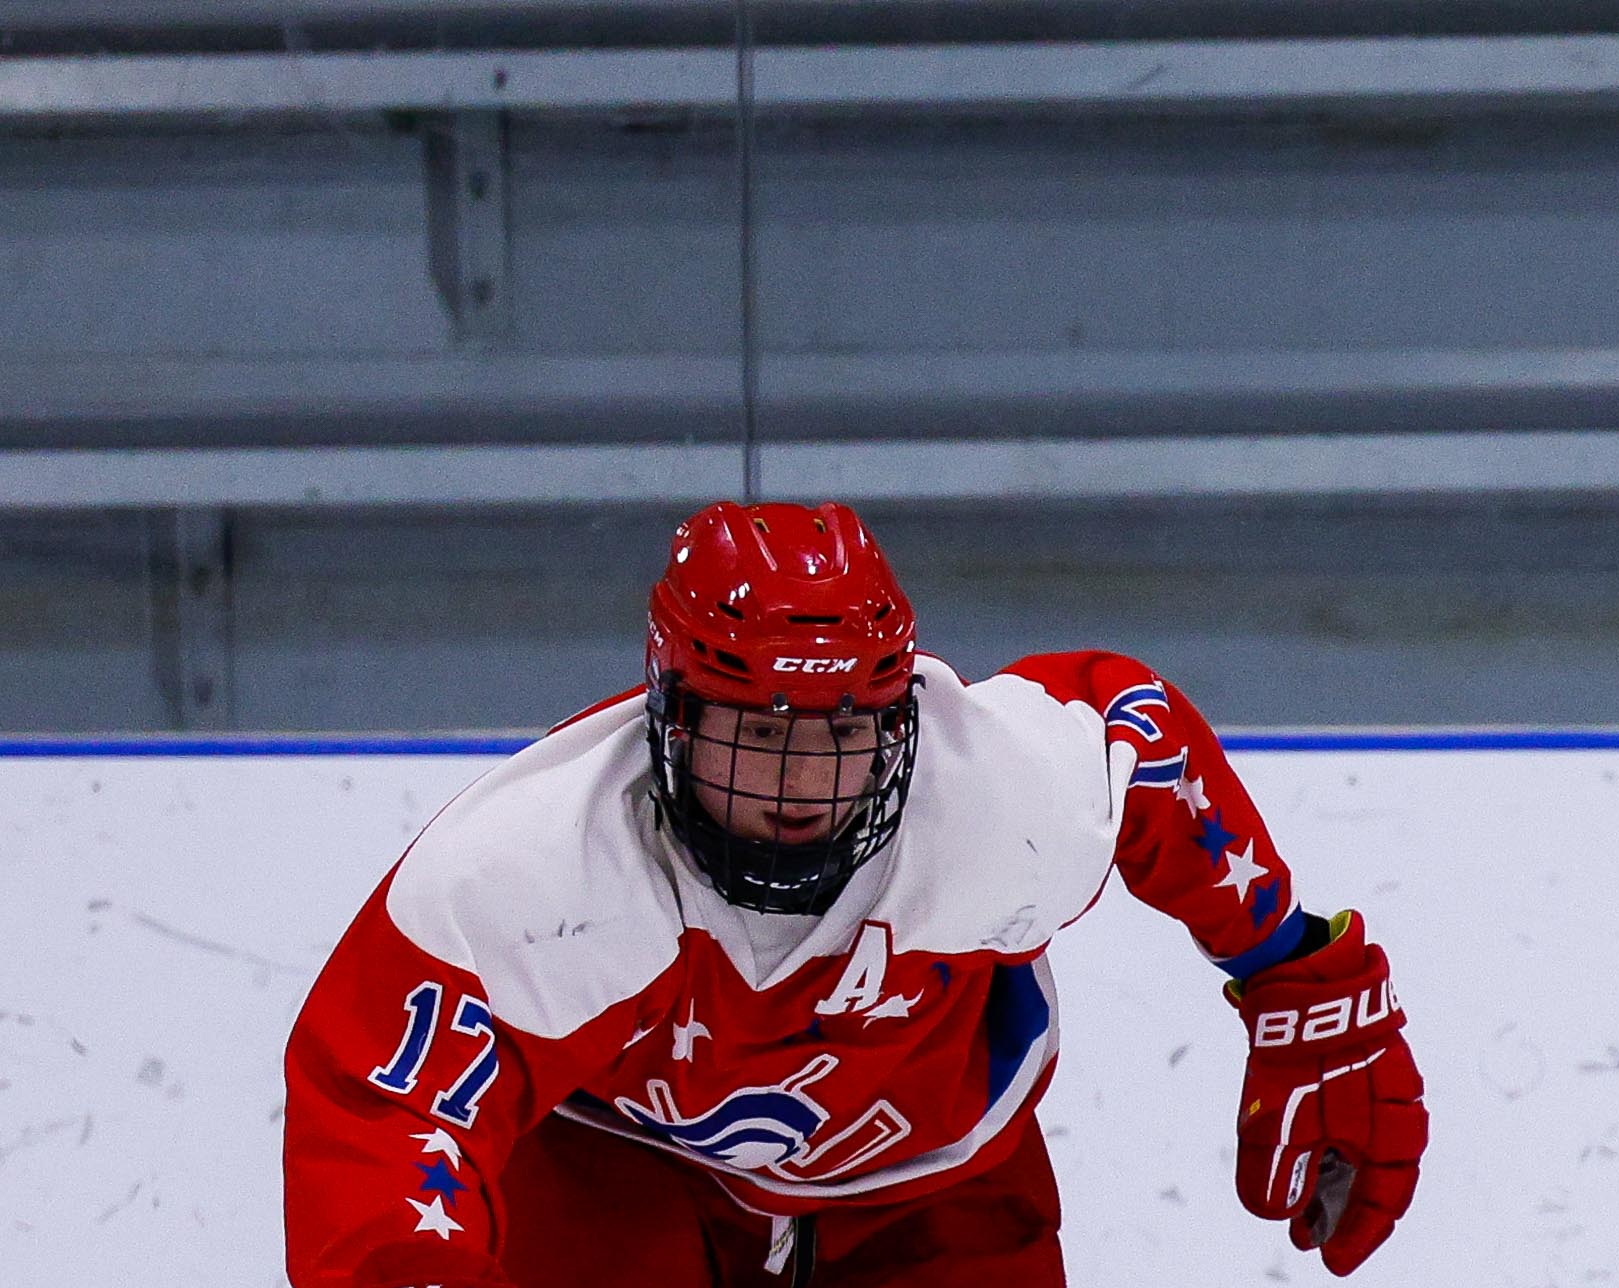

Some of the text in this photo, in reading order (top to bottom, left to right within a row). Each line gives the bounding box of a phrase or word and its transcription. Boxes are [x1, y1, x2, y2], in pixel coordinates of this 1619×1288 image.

[772, 656, 859, 675] CCM
[813, 919, 891, 1015] A
[367, 980, 500, 1129] 17
